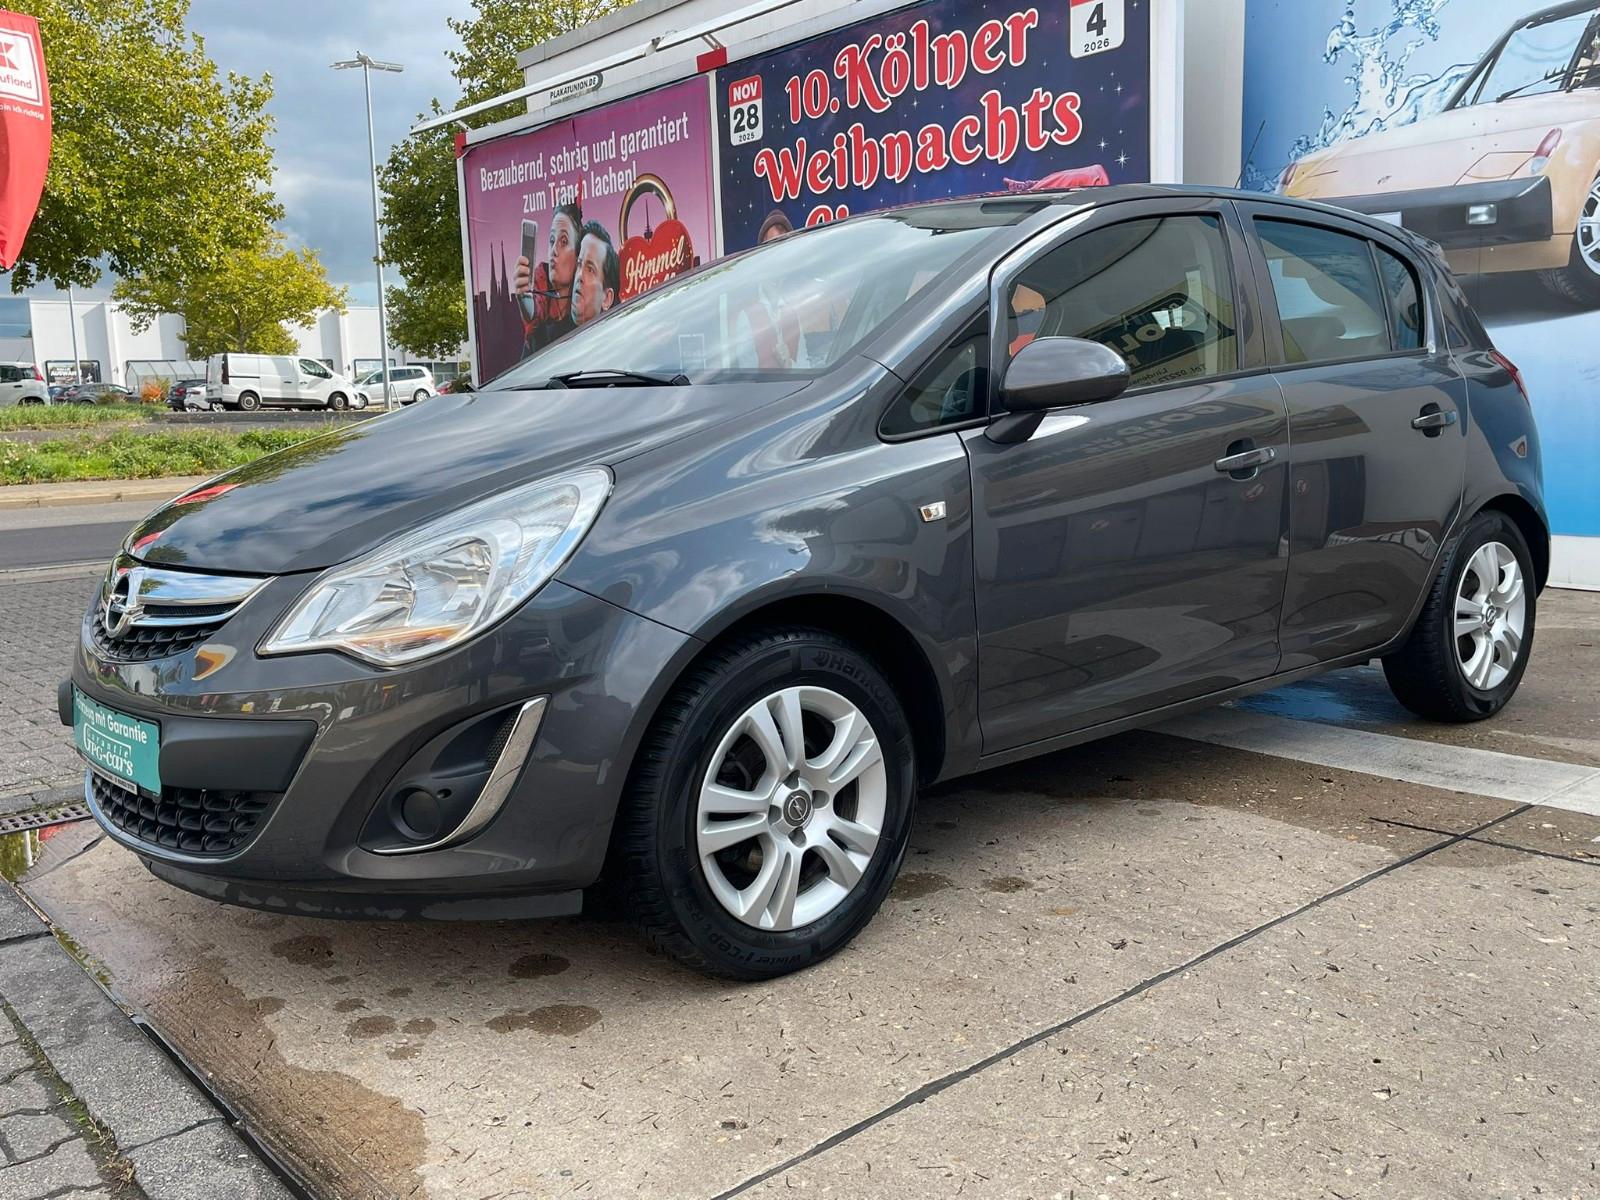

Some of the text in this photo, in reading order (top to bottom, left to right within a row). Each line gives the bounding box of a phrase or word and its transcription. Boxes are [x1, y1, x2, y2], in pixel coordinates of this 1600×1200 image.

[1086, 2, 1107, 37] 4
[1084, 38, 1110, 53] 2026
[550, 76, 596, 99] PLAKATUNION.DE
[733, 81, 758, 102] NOV
[733, 103, 759, 134] 28
[480, 152, 547, 192] Bezaubernd,
[592, 131, 616, 164] und
[620, 111, 689, 160] garantiert
[738, 132, 755, 142] 2025
[754, 88, 1082, 203] Weihnachts
[523, 189, 547, 214] zum
[591, 160, 637, 198] lachen!
[625, 235, 685, 293] Himmel
[95, 710, 106, 728] mit
[107, 714, 147, 744] Garantie
